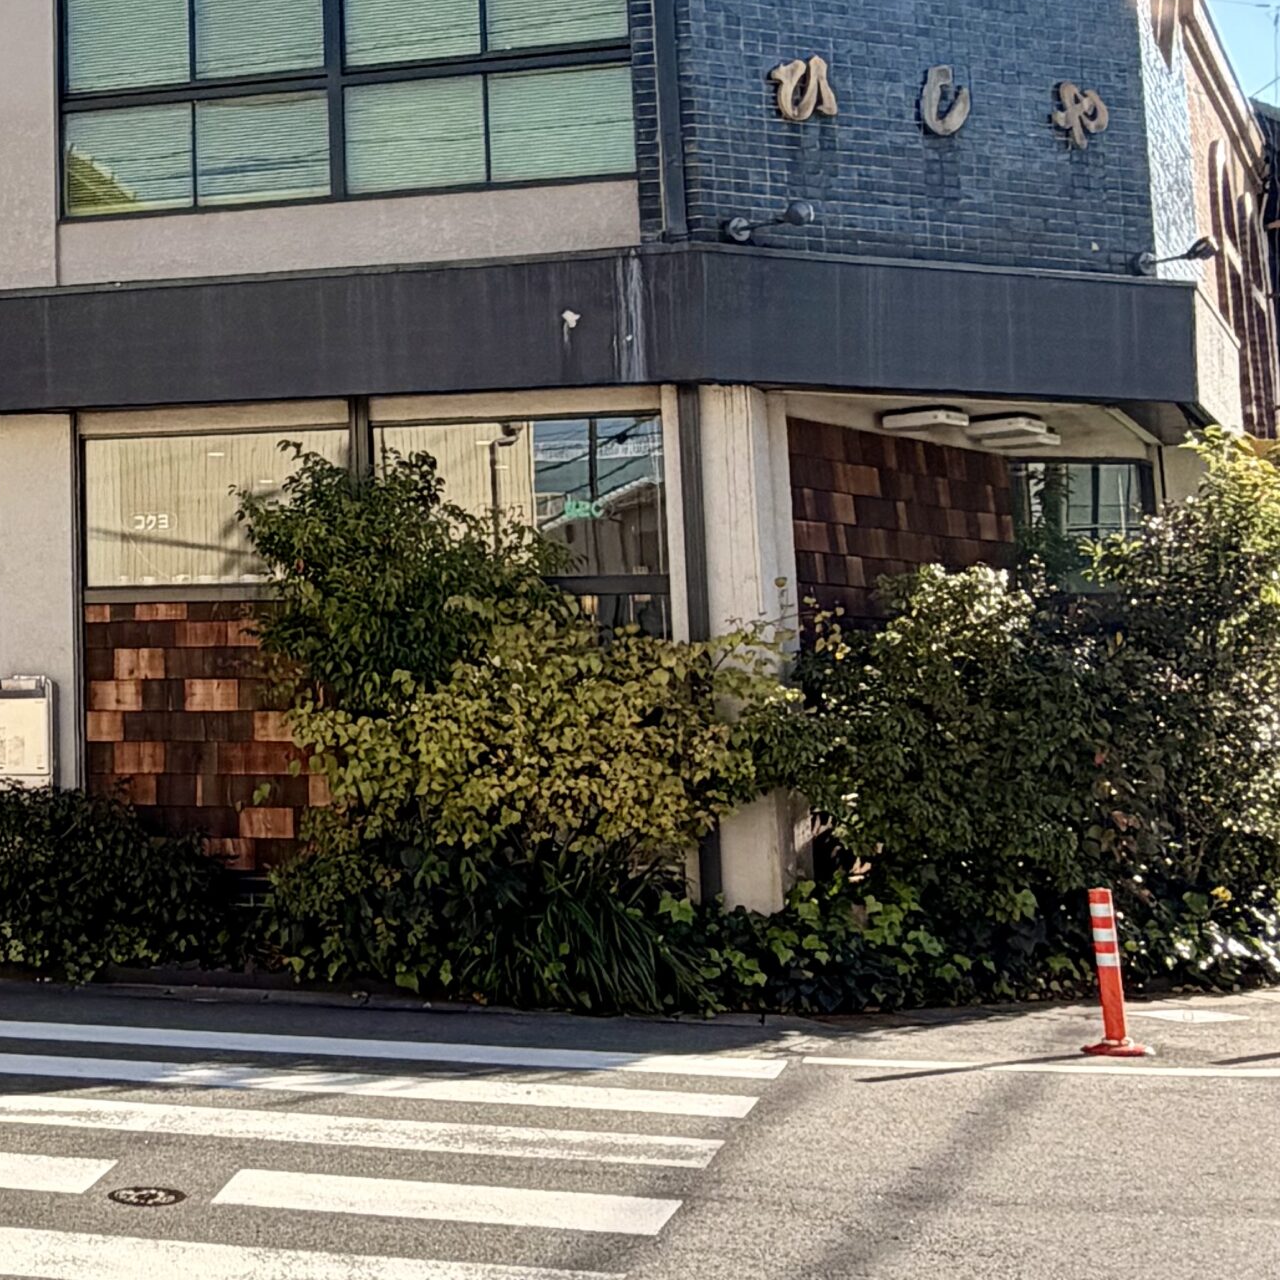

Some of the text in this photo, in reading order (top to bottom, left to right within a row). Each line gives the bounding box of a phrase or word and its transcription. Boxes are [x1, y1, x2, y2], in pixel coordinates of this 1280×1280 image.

[770, 55, 1109, 150] ひしや
[133, 513, 170, 531] コクヨ
